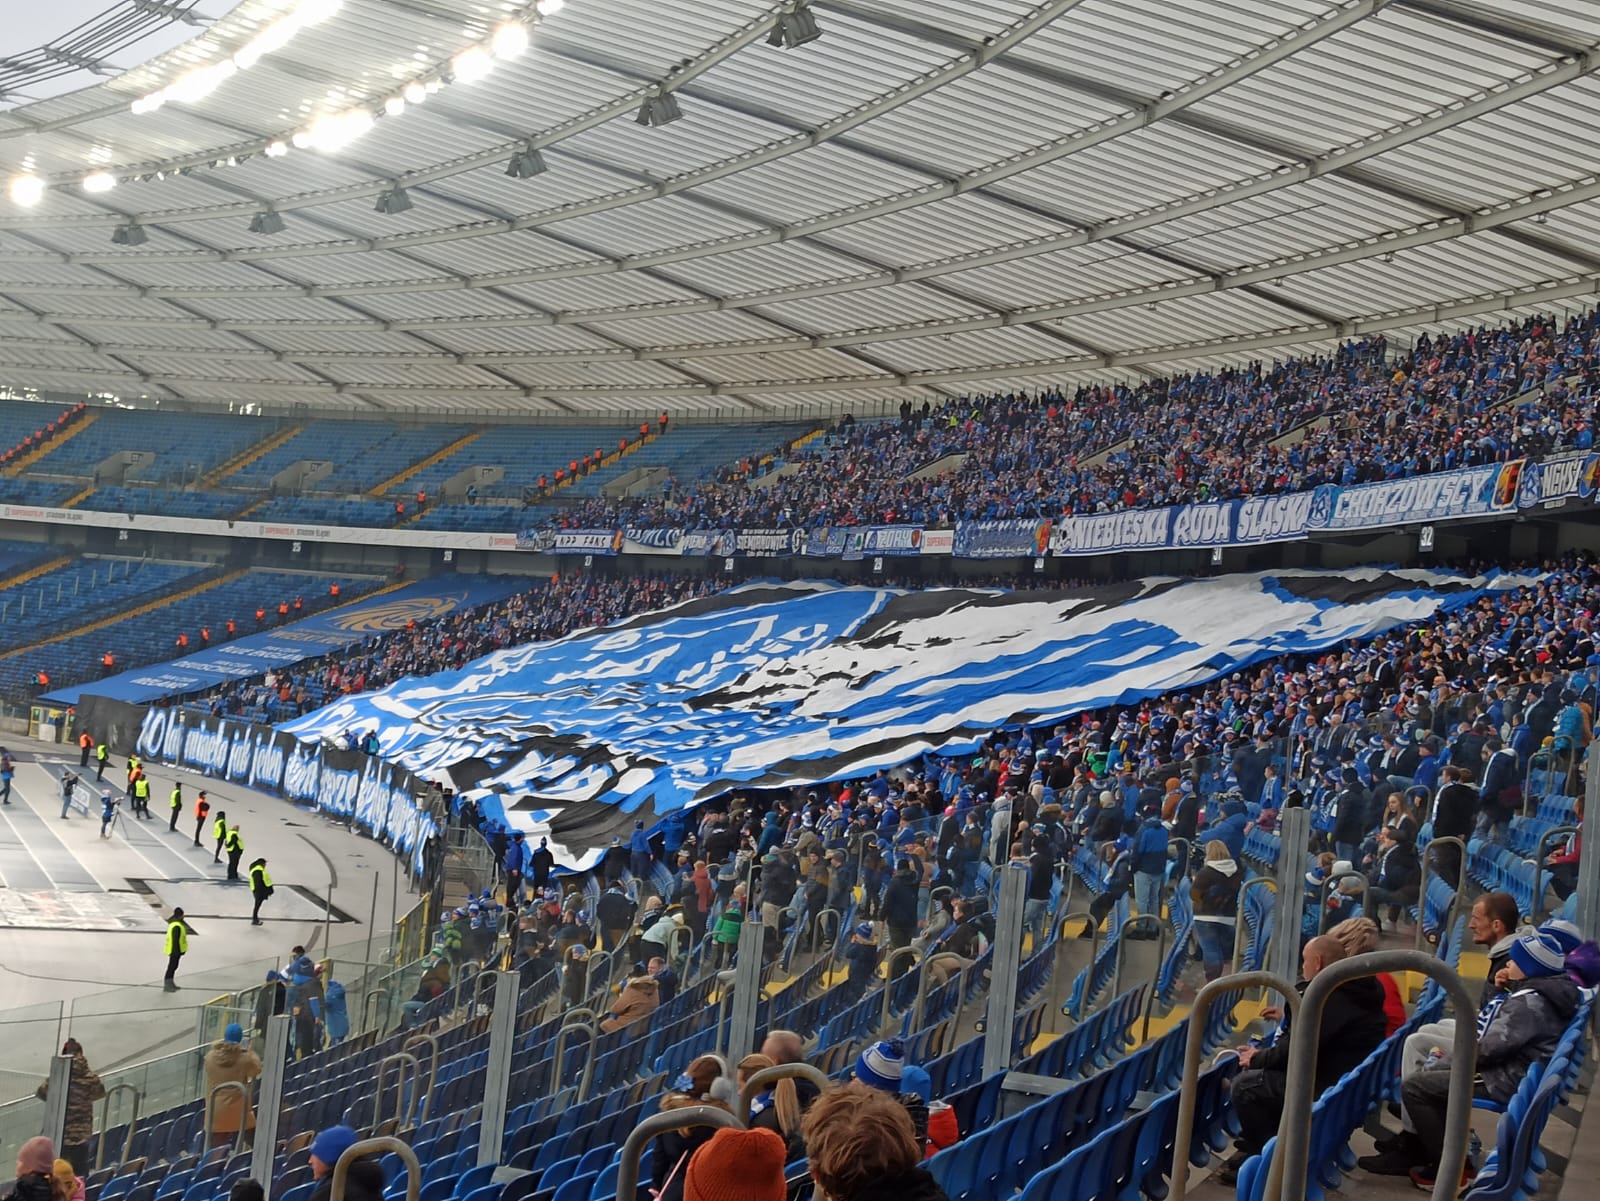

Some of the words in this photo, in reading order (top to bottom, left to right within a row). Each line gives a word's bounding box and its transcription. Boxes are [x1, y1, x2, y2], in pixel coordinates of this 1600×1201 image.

[1336, 469, 1494, 519] CHORZOWSCY
[1071, 507, 1171, 550] NIEBIESKA
[1173, 503, 1232, 546] RUDA
[1420, 525, 1434, 546] 32
[292, 542, 301, 552] 25
[1212, 548, 1222, 561] 31
[584, 556, 593, 567] 27
[873, 557, 883, 570] 29
[136, 706, 166, 757] 10
